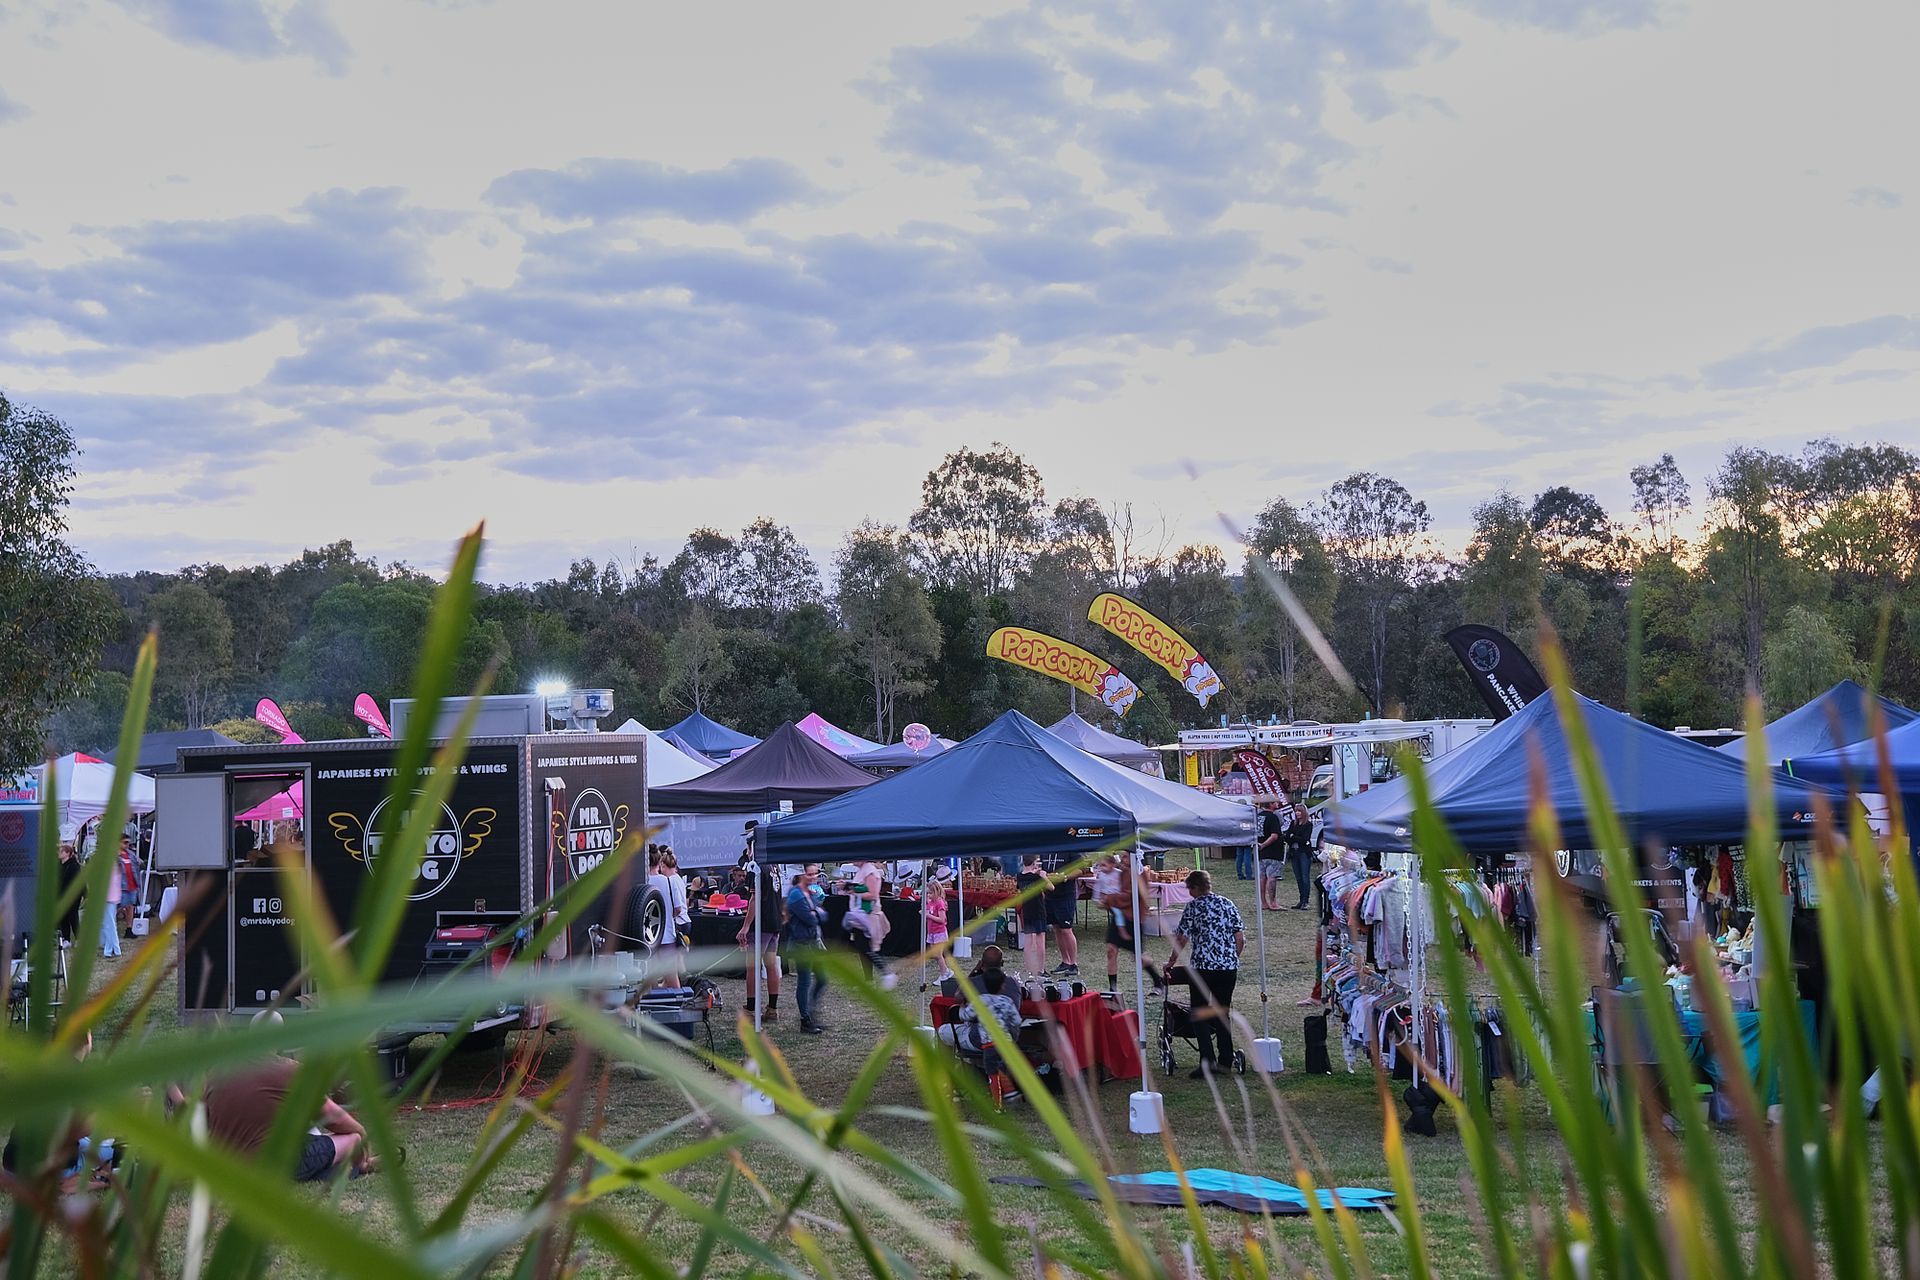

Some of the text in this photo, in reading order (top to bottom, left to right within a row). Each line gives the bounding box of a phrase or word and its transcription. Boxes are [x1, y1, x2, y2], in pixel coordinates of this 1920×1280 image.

[1102, 597, 1186, 668] POPCORN
[1001, 630, 1099, 684] POPCORN
[261, 705, 286, 727] TORNADO
[356, 705, 368, 717] HOT
[1270, 731, 1291, 739] GLUTEN
[317, 763, 508, 779] JAPANESE STYL OTDS & WINGS
[537, 754, 638, 768] JAPANESE STYLE HOTDOGS & WINGS
[1244, 762, 1265, 798] UTANESE
[579, 806, 602, 826] MR.
[368, 833, 457, 855] TYO
[569, 828, 612, 852] TOKYO
[1630, 879, 1653, 887] ARKETS
